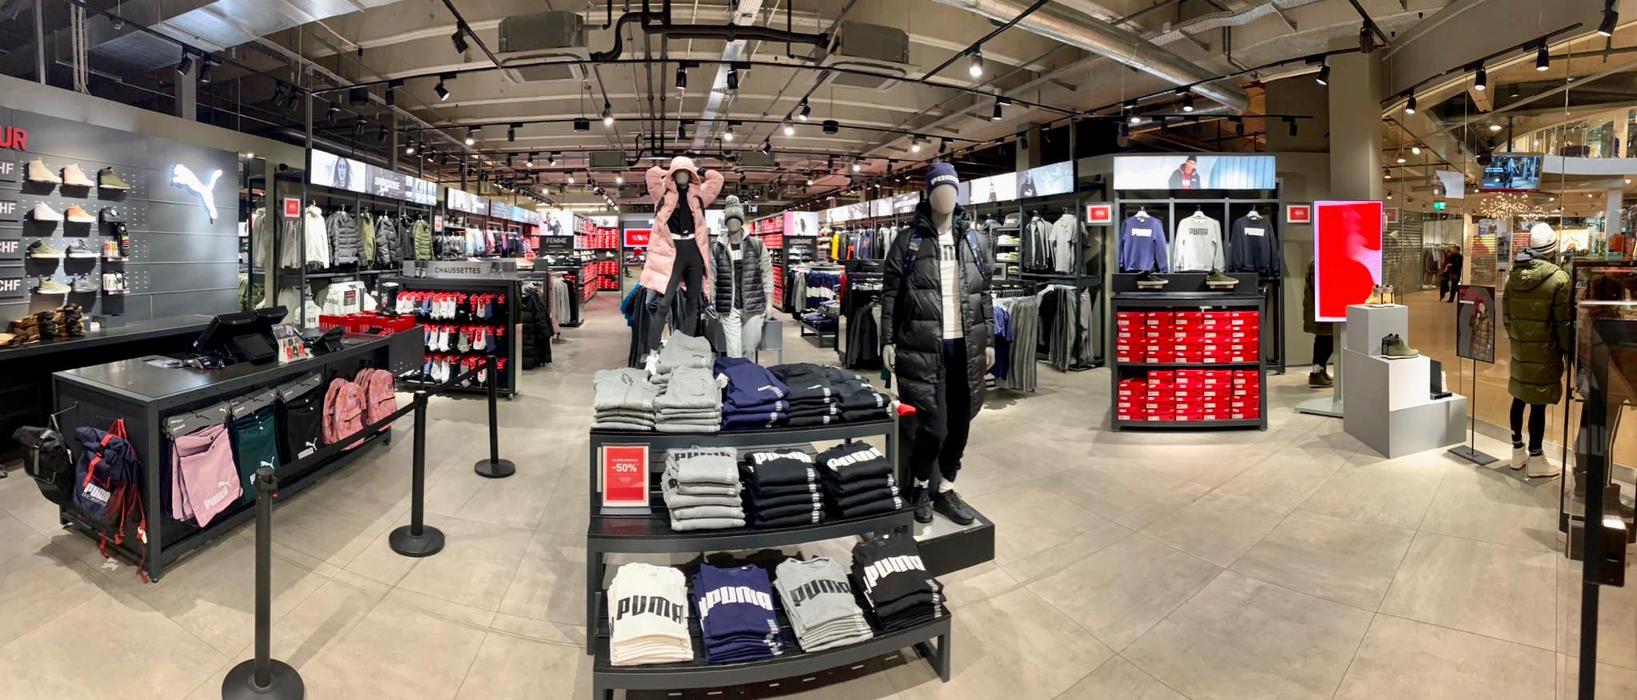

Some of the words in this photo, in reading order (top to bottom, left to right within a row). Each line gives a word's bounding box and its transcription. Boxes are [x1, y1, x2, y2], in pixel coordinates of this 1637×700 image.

[0, 127, 29, 150] UR
[0, 241, 19, 253] HF
[434, 266, 481, 274] CHAUSSETTES
[864, 555, 926, 588] PUMA
[705, 586, 774, 611] PUMA
[789, 578, 851, 607] PUMA
[616, 594, 684, 625] PUMA
